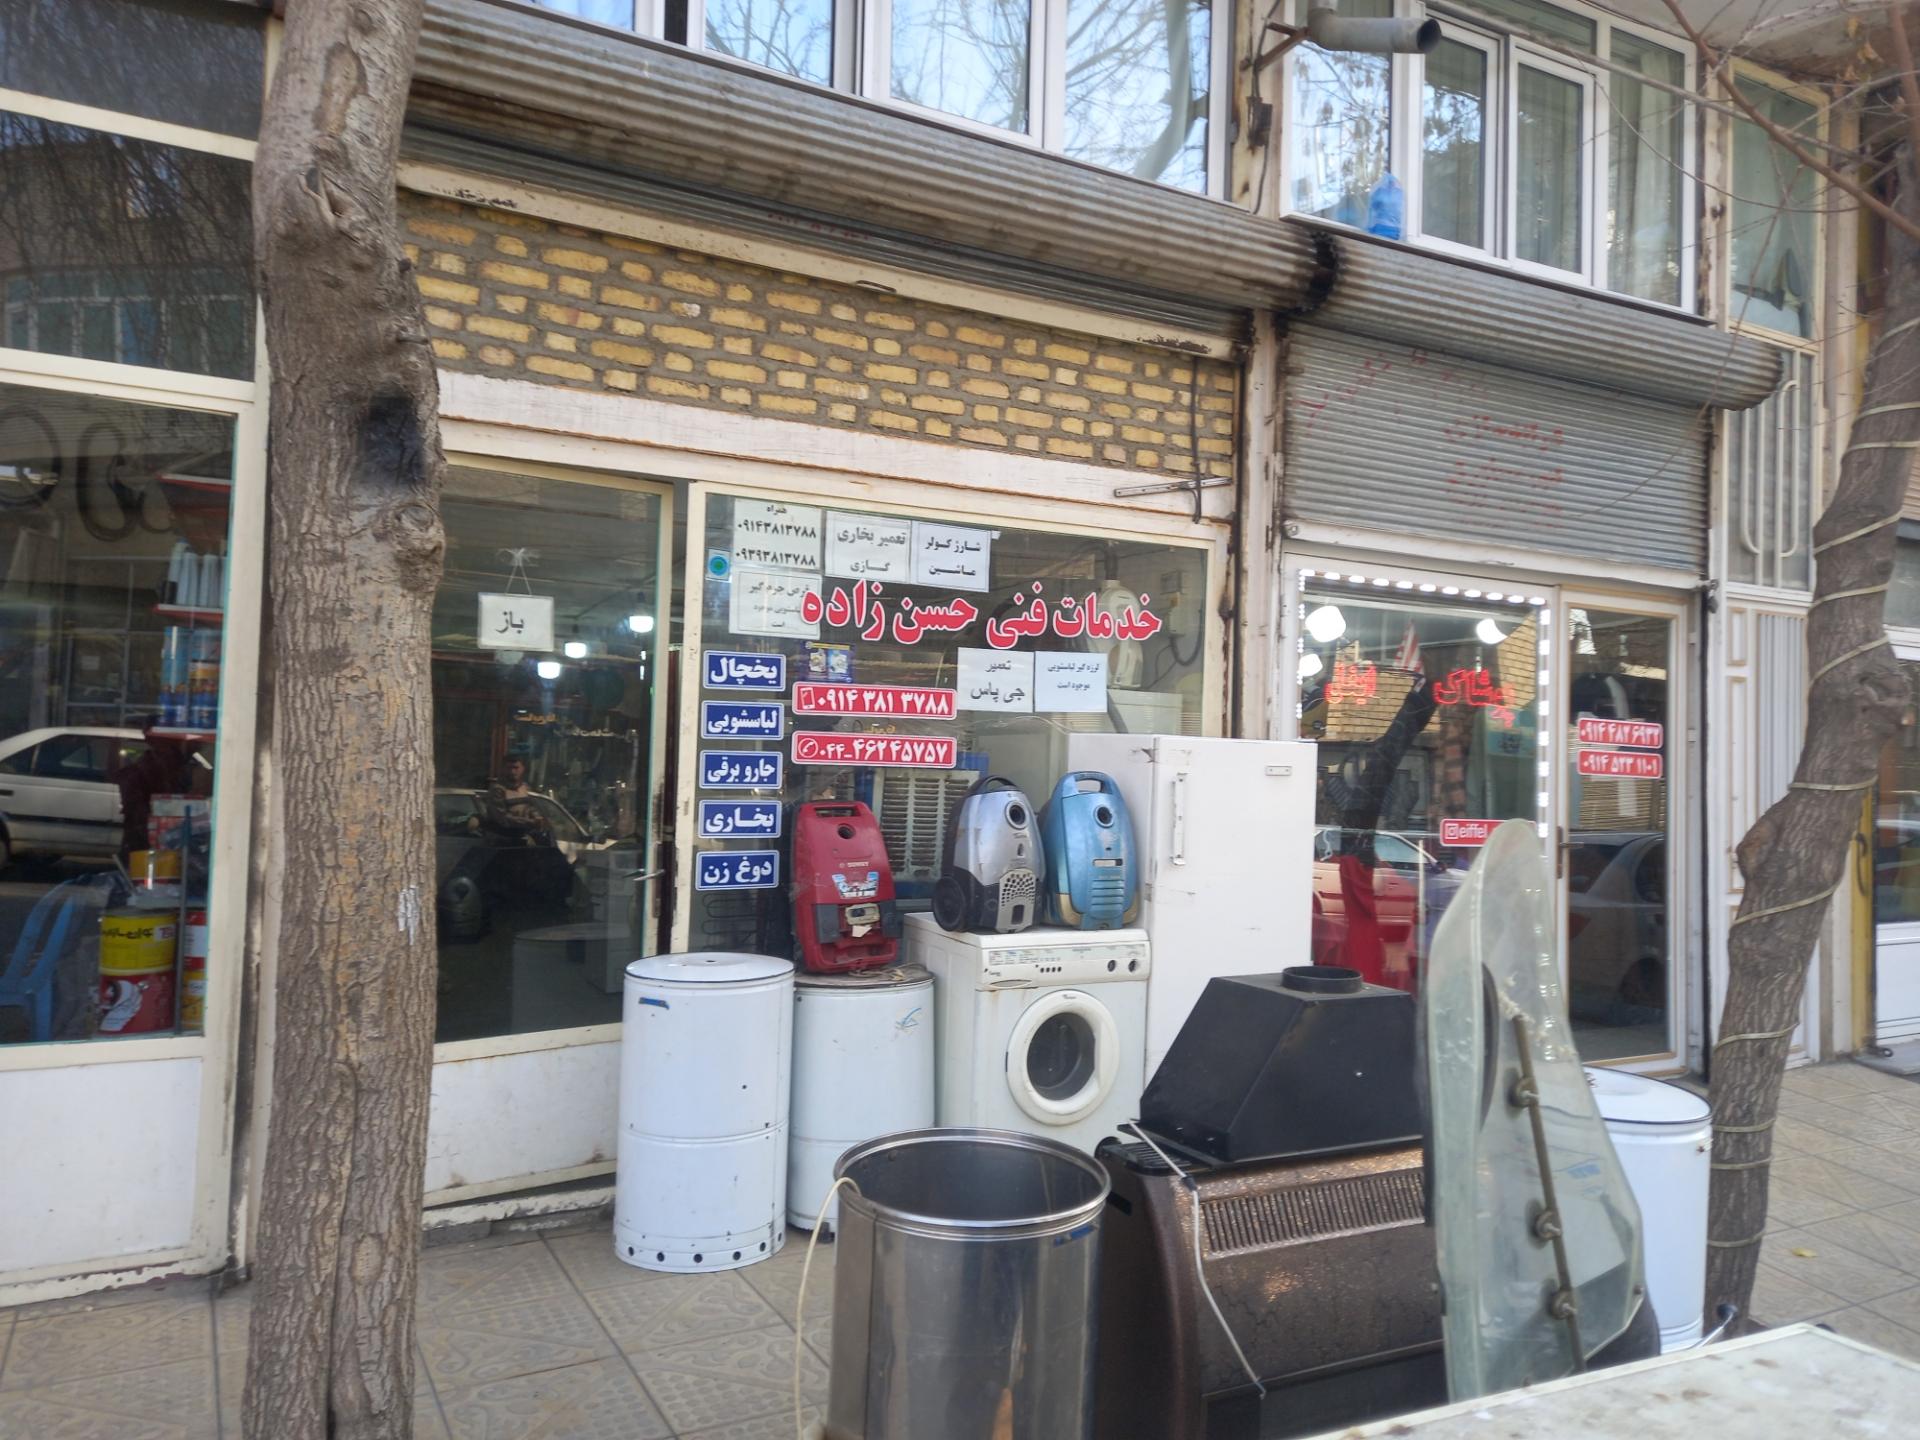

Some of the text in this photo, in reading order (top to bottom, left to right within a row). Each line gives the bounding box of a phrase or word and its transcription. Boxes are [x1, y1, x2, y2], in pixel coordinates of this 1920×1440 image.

[836, 526, 908, 547] تعمیر بخاری
[928, 563, 977, 577] ماشین
[495, 610, 525, 635] باز
[799, 579, 1163, 649] خدمات فنی حسن زاده
[710, 656, 779, 686] یخچال
[817, 688, 949, 715] ۰۹۱۴ ۳۸۱ ۳۷۸۸
[970, 681, 1026, 704] جی پاس
[707, 708, 778, 735] لباسشویی
[707, 758, 777, 784] جارو برقی
[705, 806, 775, 834] بخاری
[703, 855, 773, 885] دوغ زن
